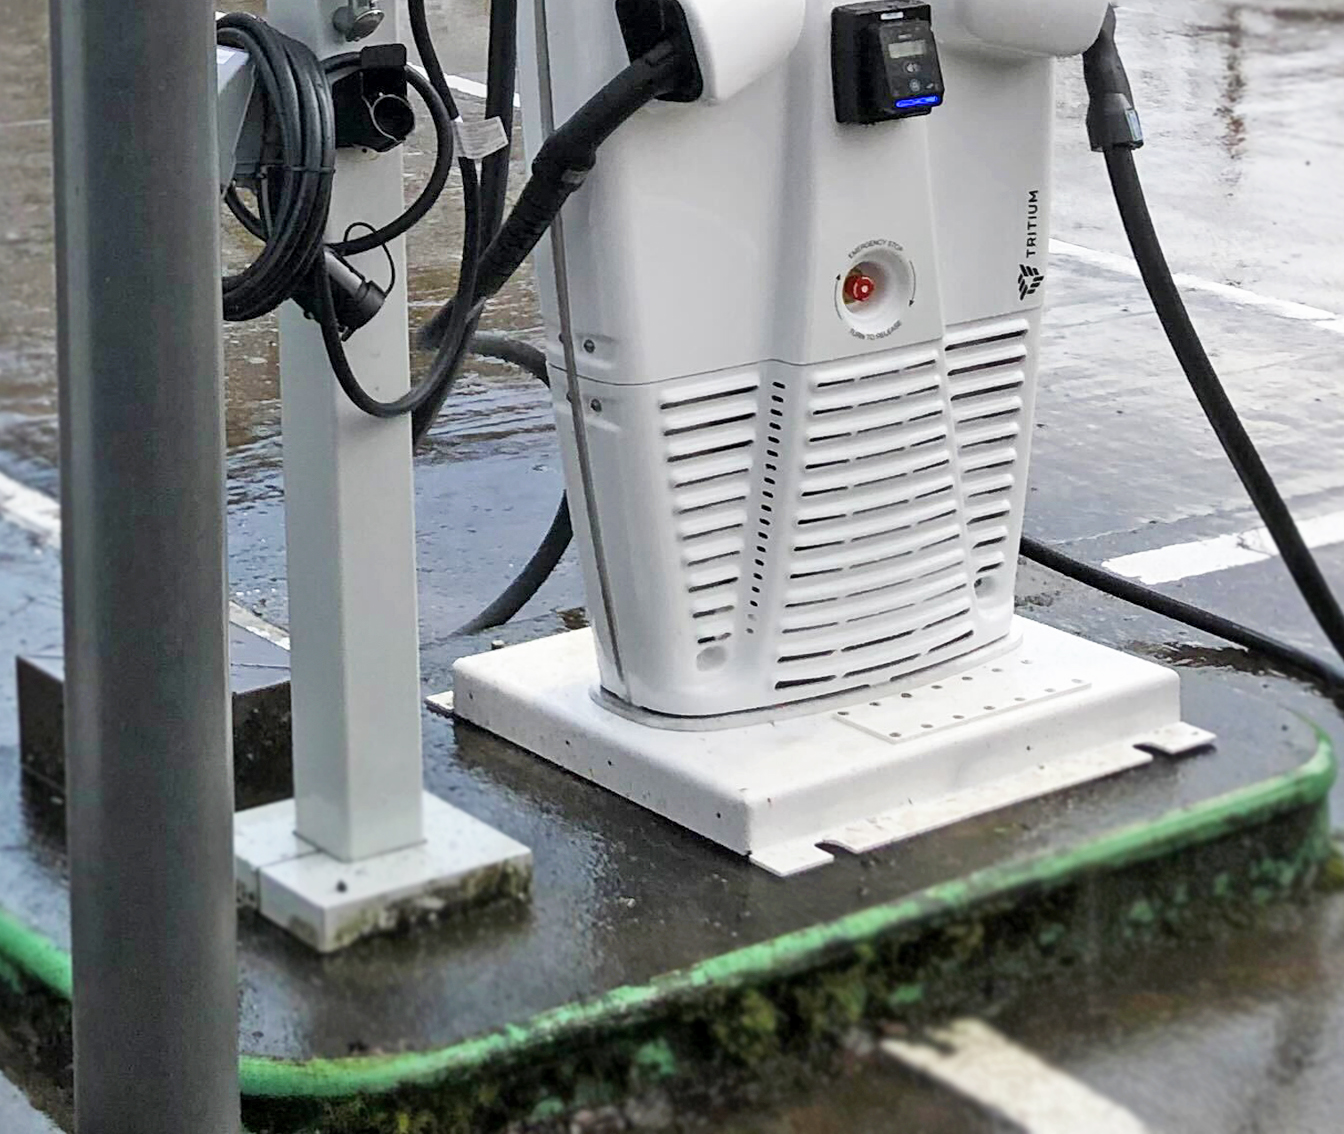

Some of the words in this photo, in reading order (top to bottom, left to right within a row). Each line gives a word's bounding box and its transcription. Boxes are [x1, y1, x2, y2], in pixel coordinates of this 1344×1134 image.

[1026, 189, 1039, 259] TRITIUM
[847, 238, 887, 260] EMERGENCY
[887, 239, 904, 252] STOP
[849, 327, 866, 341] TURN
